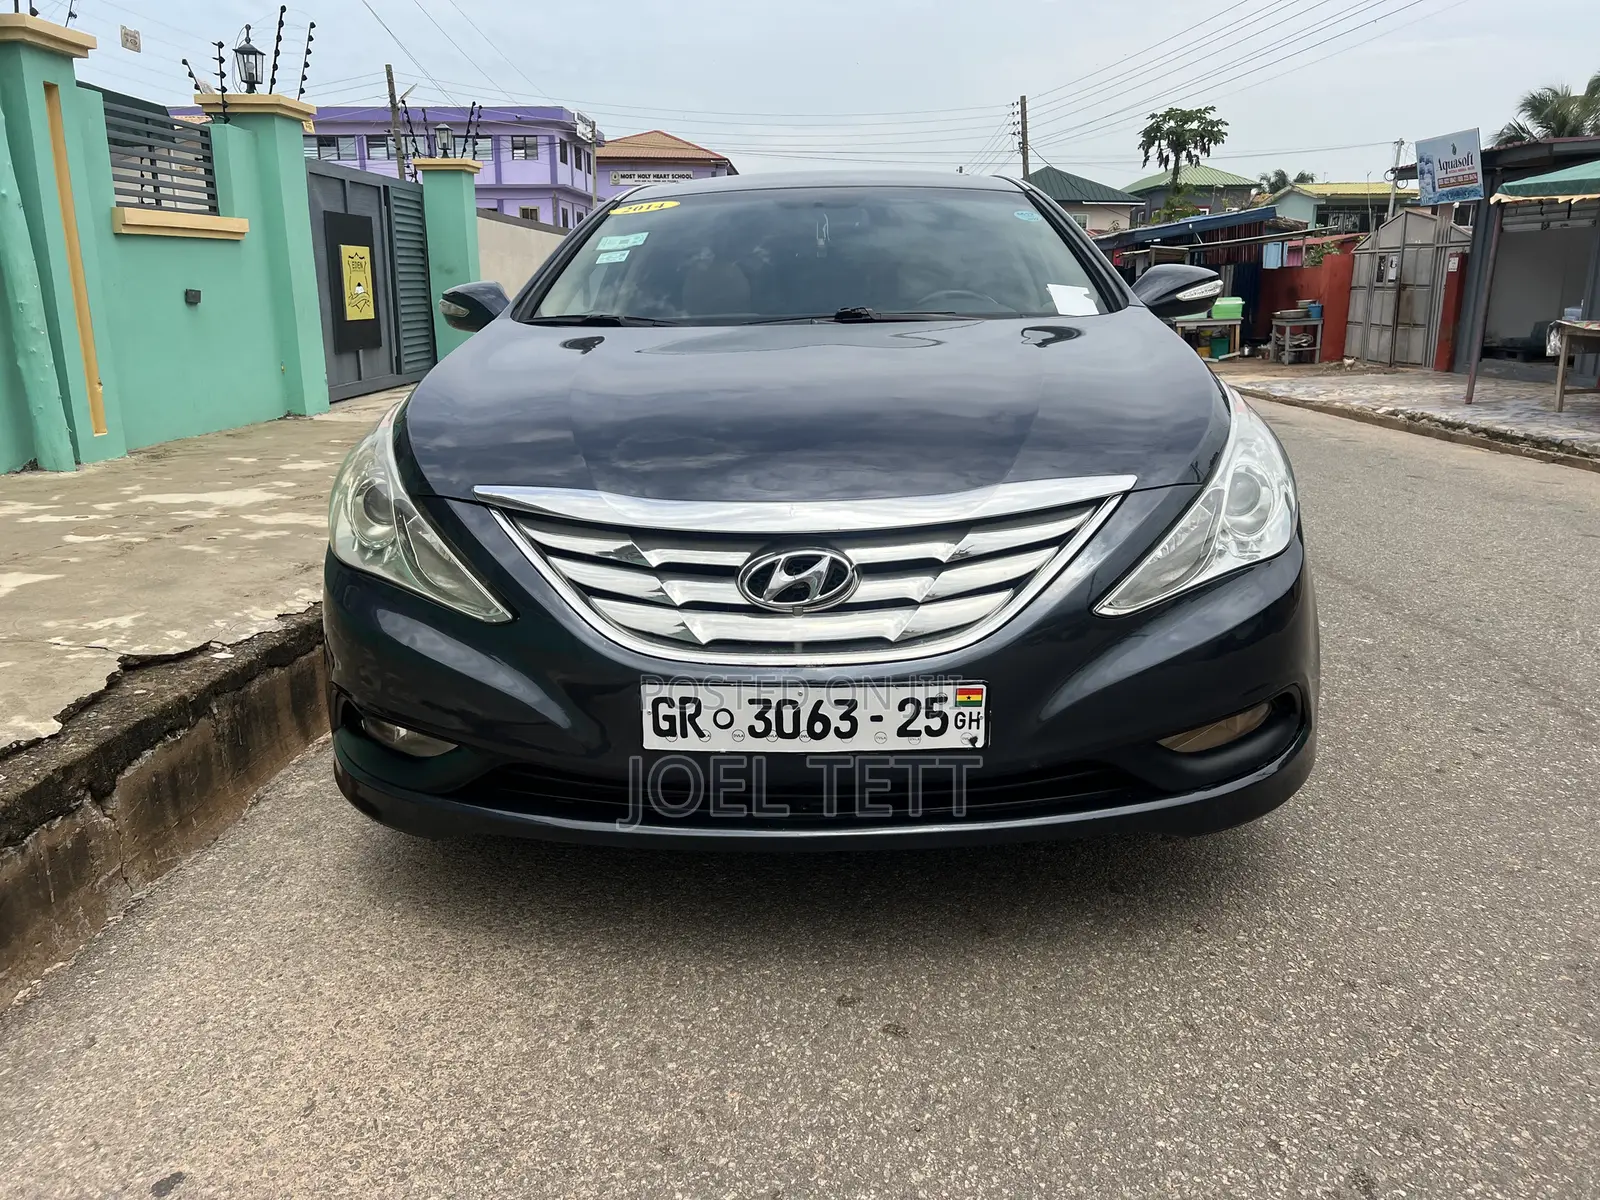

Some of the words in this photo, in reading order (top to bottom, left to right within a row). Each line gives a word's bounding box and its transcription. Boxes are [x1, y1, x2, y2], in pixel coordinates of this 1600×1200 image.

[1437, 152, 1474, 174] Aquasoft
[623, 202, 665, 213] 2014
[651, 696, 706, 739] GR
[747, 698, 859, 741] 3063
[896, 696, 949, 739] 25
[954, 711, 981, 730] GH
